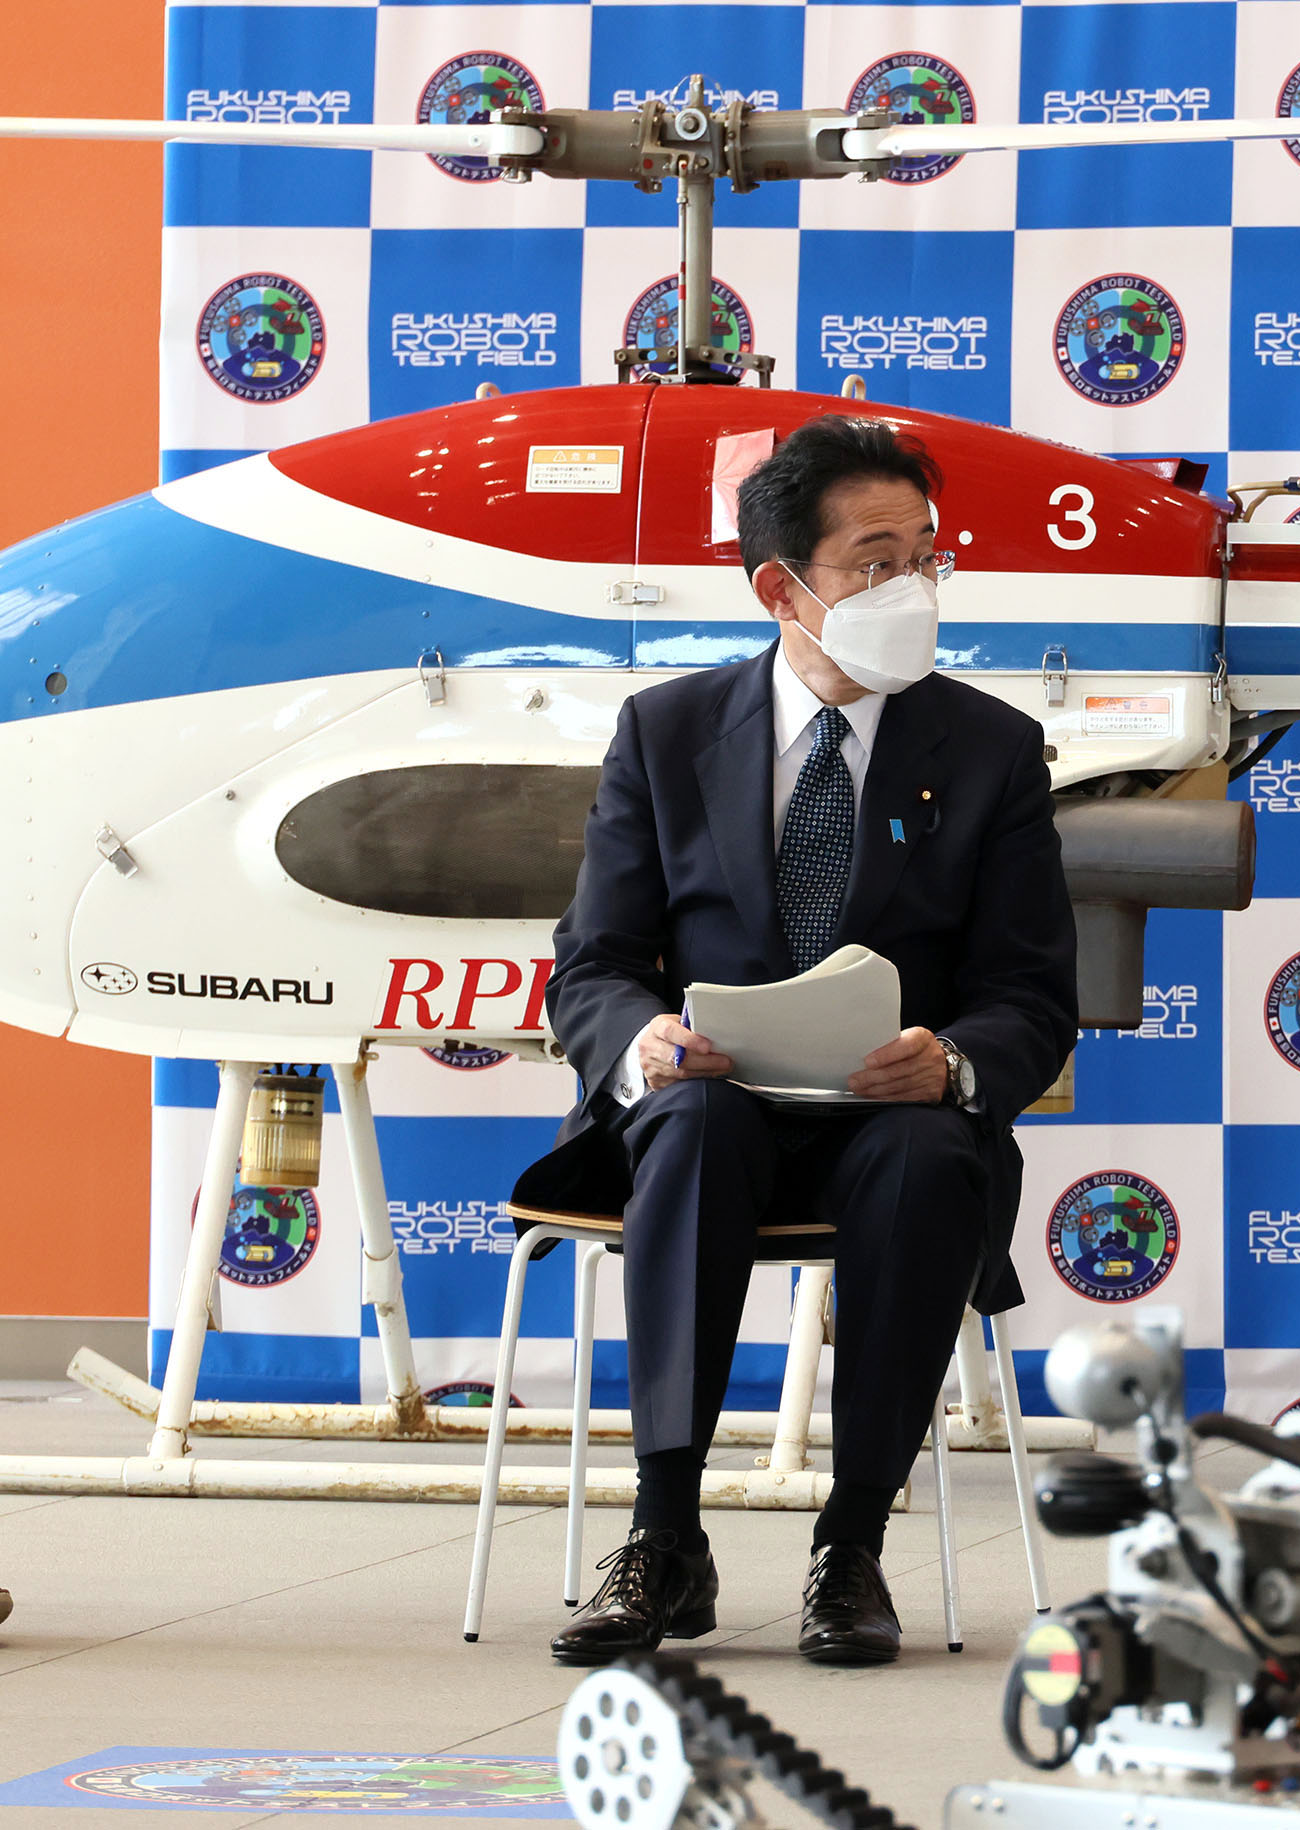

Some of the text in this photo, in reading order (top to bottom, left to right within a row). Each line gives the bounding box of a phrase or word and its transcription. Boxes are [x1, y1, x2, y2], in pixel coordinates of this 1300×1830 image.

[187, 90, 350, 106] FUKUSHIMA
[1044, 88, 1210, 106] FUKUSHIMA
[187, 106, 350, 124] ROBOT
[1044, 104, 1209, 124] ROBOT
[1057, 277, 1182, 342] FUKUSHIMA ROBOT TEST FIELD
[392, 312, 556, 329] FUKUSHIMA
[821, 316, 987, 332] FUKUSHIMA
[392, 328, 556, 350] ROBOT
[821, 331, 987, 354] ROBOT
[392, 350, 556, 366] TEST FIELD
[821, 353, 987, 370] TEST FIELD
[1047, 484, 1097, 550] 3
[147, 971, 333, 1005] SUBARU
[1051, 1174, 1176, 1238] FUKUSHIMA ROBOT TEST FIELD
